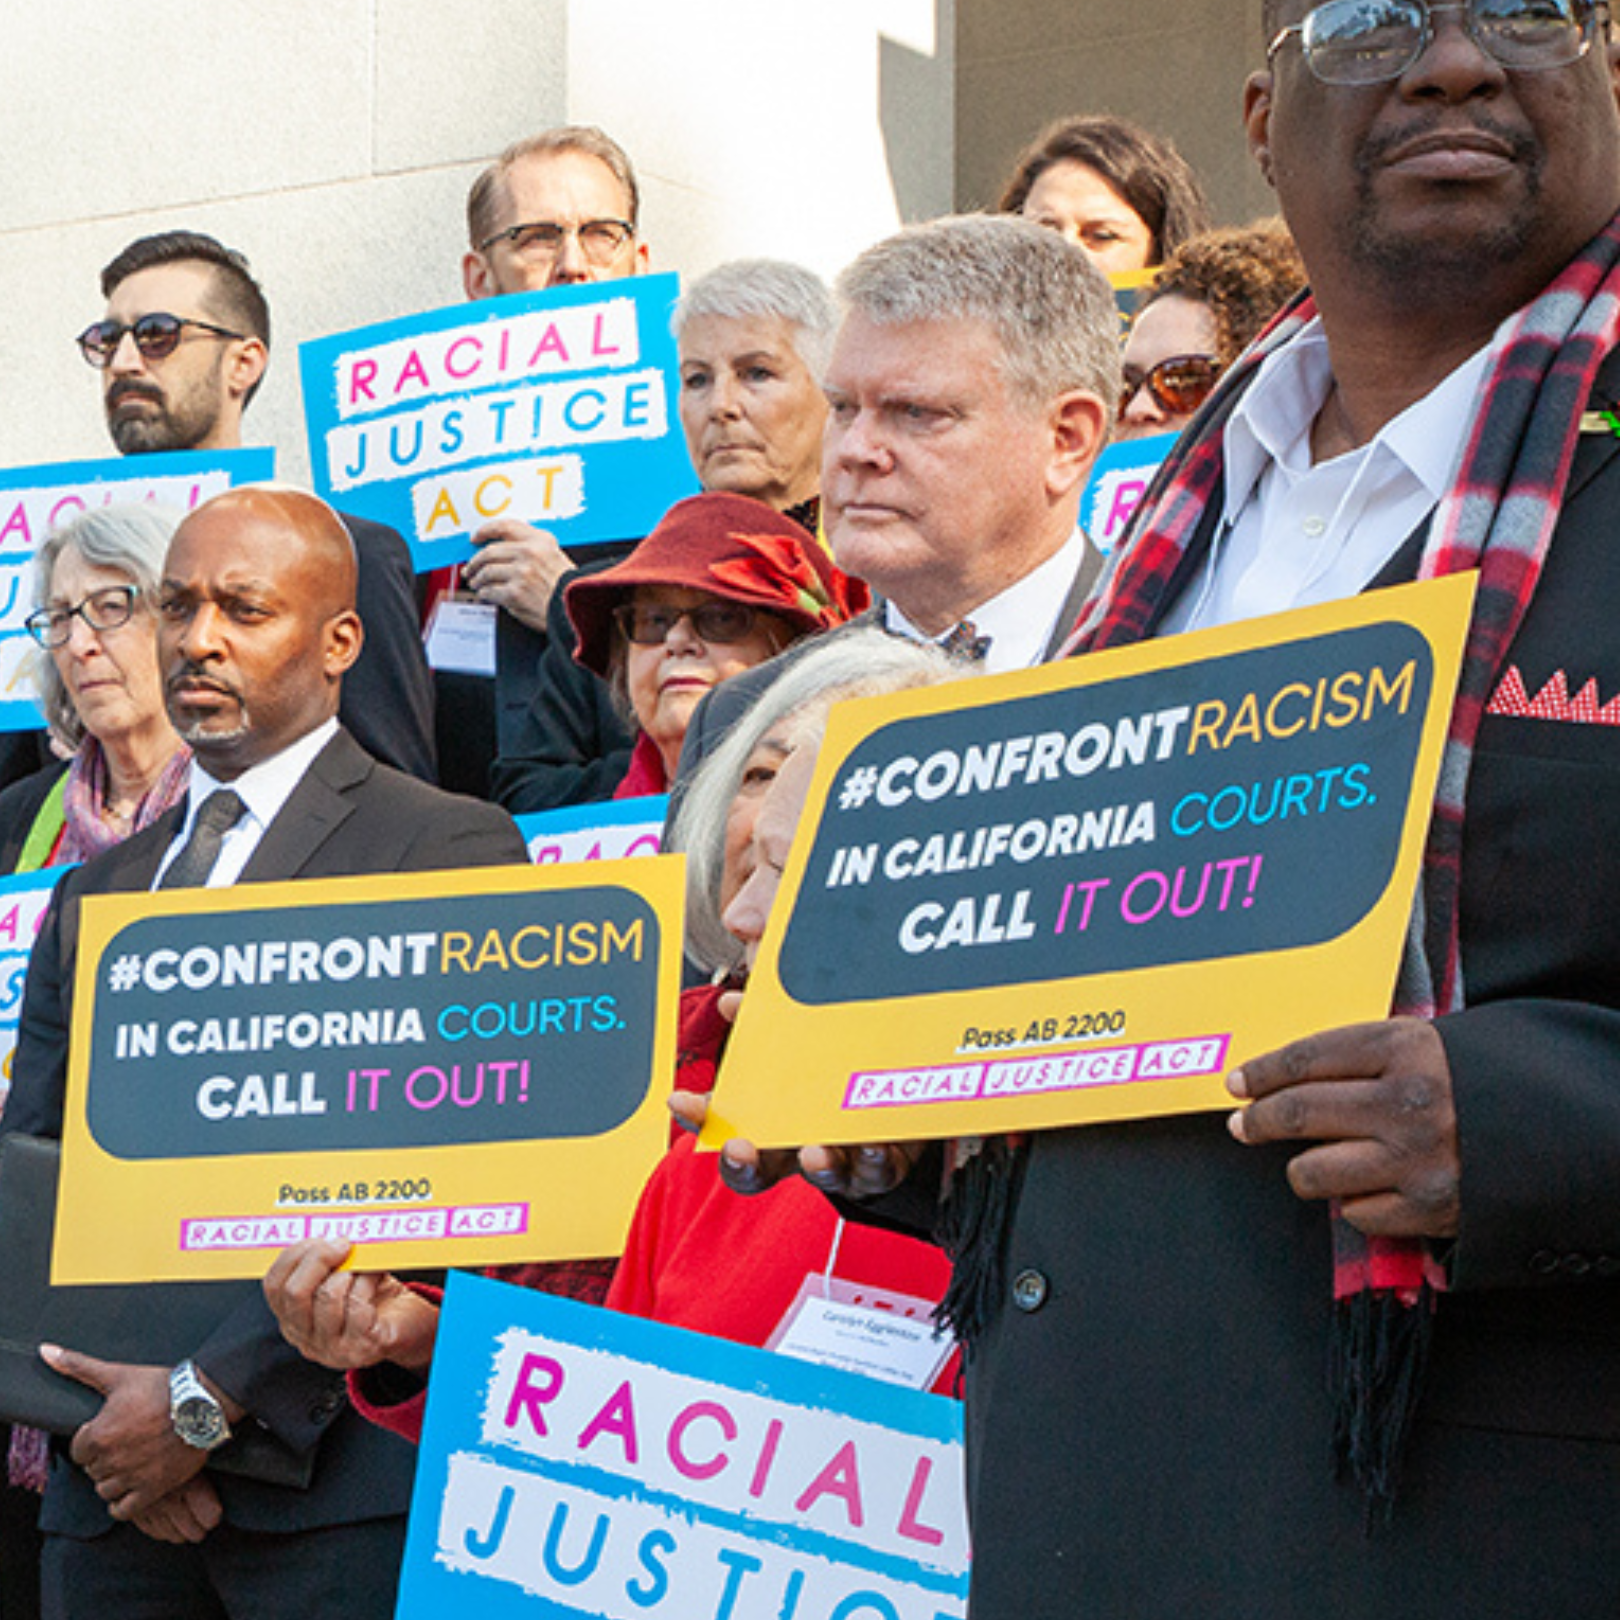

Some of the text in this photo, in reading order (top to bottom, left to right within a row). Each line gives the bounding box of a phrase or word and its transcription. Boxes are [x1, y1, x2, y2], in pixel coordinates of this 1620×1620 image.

[350, 313, 621, 404] RACIAL
[424, 465, 564, 533] ACT
[825, 763, 1378, 888] IN CALIFORNIA COURTS.
[898, 854, 1264, 954] CALL IT OUT!
[115, 993, 628, 1059] IN CALIFORNIA COURTS.
[962, 1009, 1126, 1049] Pass AB 2200
[196, 1059, 530, 1120] CALL IT OUT!
[856, 1043, 1214, 1100] RACIAL JUSTICE ACT
[278, 1178, 431, 1204] Pass AB 2200
[190, 1209, 515, 1244] RACIAL JUSTICE ACT
[504, 1353, 944, 1546] RACIAL
[464, 1485, 966, 1620] JUSTI
